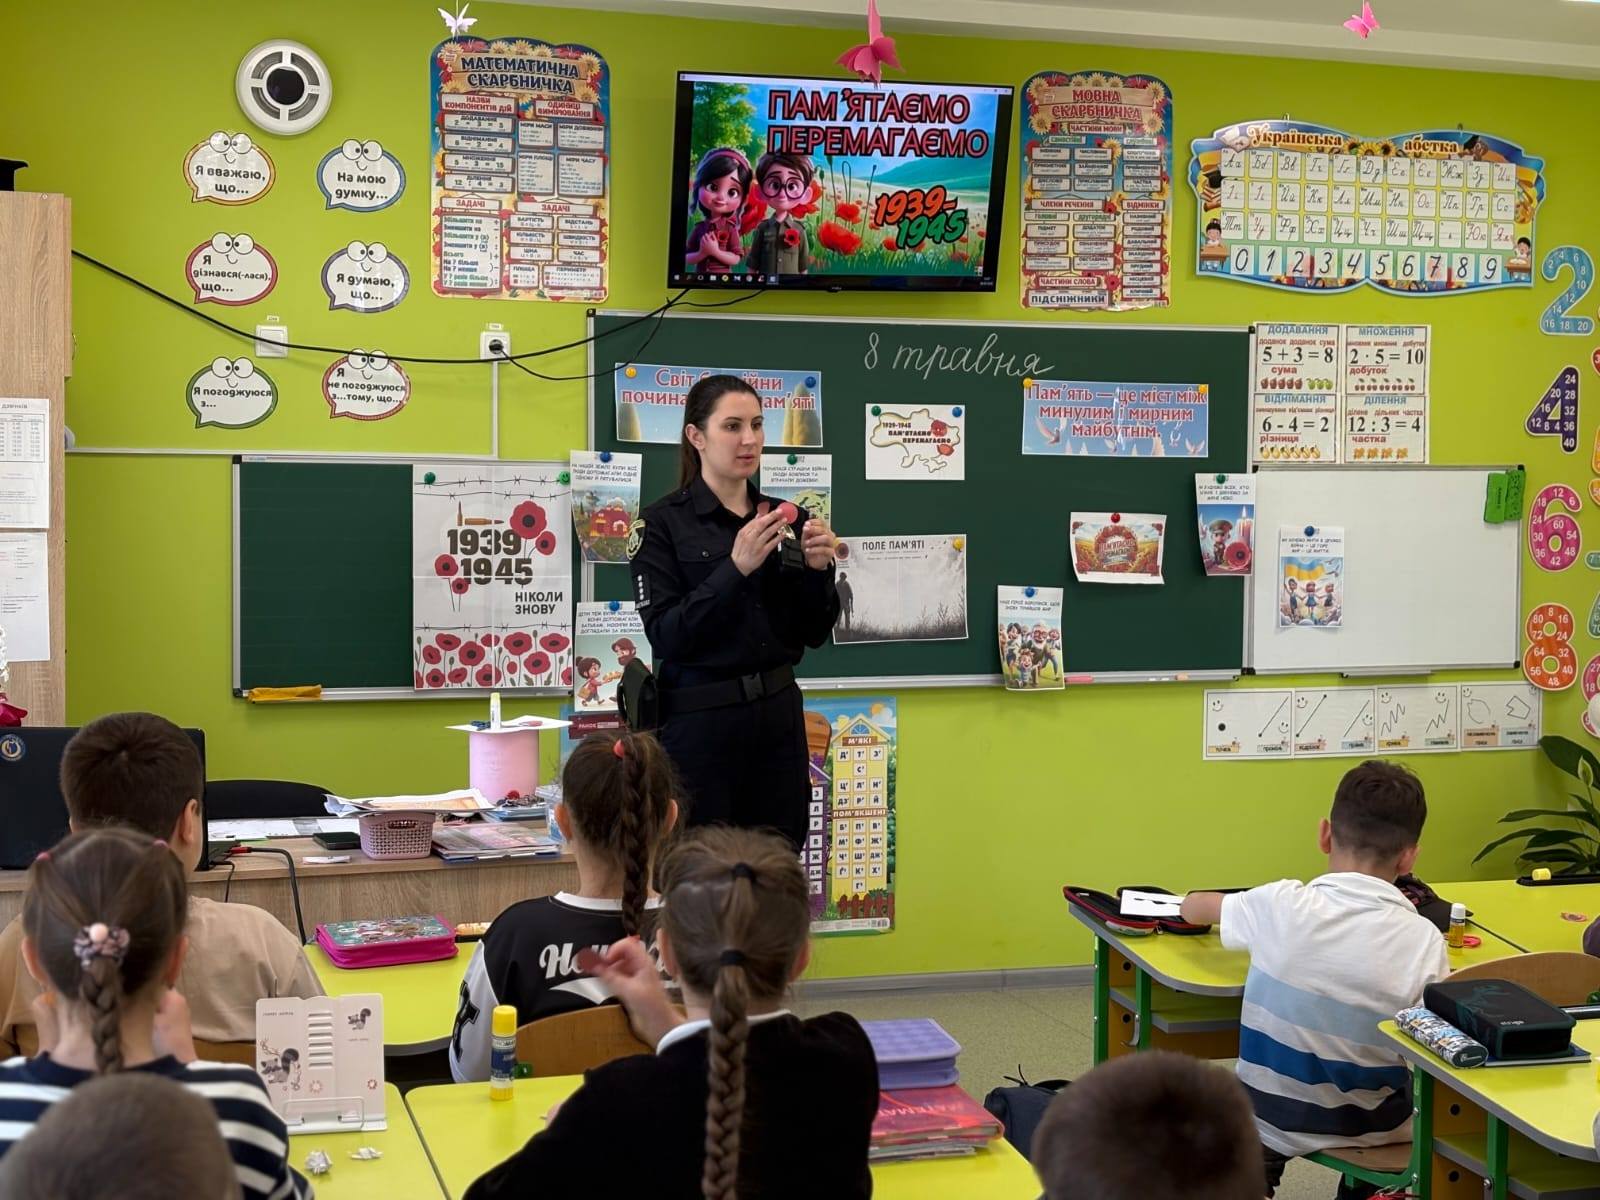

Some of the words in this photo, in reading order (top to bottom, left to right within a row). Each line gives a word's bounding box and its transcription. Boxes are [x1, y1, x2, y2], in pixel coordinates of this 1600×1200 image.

[461, 57, 579, 78] МАТЕМАТИЧНА
[467, 73, 573, 93] СКАРБНИЧКА
[1072, 89, 1121, 102] МОВНА
[445, 102, 497, 112] КОМПОНЕНТІВ
[499, 104, 512, 113] ДІЙ
[768, 88, 970, 123] ПАМ’ЯТАЄМО
[1052, 104, 1142, 121] СКАРБНИЧКА
[767, 124, 989, 158] ПЕРЕМАГАЄМО
[1247, 124, 1343, 147] Українська
[1404, 136, 1458, 153] абетка
[195, 165, 204, 176] Я
[207, 167, 266, 181] вважаю,
[337, 172, 354, 183] На
[356, 175, 386, 185] мою
[215, 183, 249, 195] що...
[335, 188, 388, 200] думку...
[456, 200, 485, 208] ЗАДАЧІ
[541, 204, 571, 213] ЗАДАЧІ
[874, 185, 958, 226] 1939-
[1040, 200, 1063, 208] ЧЛЕНИ
[1064, 201, 1094, 209] РЕЧЕННЯ
[1126, 201, 1159, 209] ВІДМІНКИ
[895, 208, 969, 248] 1945
[203, 255, 212, 265] Я
[1235, 248, 1249, 272] 0
[1266, 249, 1276, 272] 1
[1292, 250, 1304, 273] 2
[1319, 251, 1332, 274] 3
[1347, 252, 1362, 275] 4
[1375, 254, 1390, 276] 5
[1402, 254, 1415, 277] 6
[1430, 255, 1442, 278] 7
[1457, 256, 1469, 279] 8
[1485, 257, 1498, 280] 9
[336, 273, 345, 283] Я
[347, 275, 395, 288] думаю,
[201, 283, 234, 294] що...
[350, 290, 383, 301] що...
[1031, 294, 1105, 304] ПІДСНІЖНИКИ
[1268, 326, 1328, 335] ДОДАВАННЯ
[1359, 327, 1414, 336] МНОЖЕННЯ
[864, 332, 879, 370] 8
[892, 333, 1055, 380] травня
[1262, 346, 1272, 362] 5
[1293, 347, 1303, 363] 3
[1324, 347, 1334, 363] 8
[1350, 348, 1359, 364] 2
[1375, 348, 1384, 364] 5
[1407, 349, 1423, 364] 10
[336, 368, 345, 378] Я
[1271, 366, 1297, 375] сума
[1350, 366, 1387, 376] добуток
[656, 368, 695, 387] Світ
[1565, 375, 1576, 384] 24
[193, 387, 201, 395] Я
[203, 388, 272, 398] погоджуюся
[328, 382, 340, 390] не
[342, 382, 406, 394] погоджуюся
[1551, 388, 1561, 398] 20
[1027, 384, 1093, 401] Пам’ять
[1118, 392, 1136, 406] це
[1141, 387, 1171, 404] міст
[1176, 389, 1207, 404] між
[1264, 395, 1326, 404] ВІДНІМАННЯ
[1565, 390, 1576, 399] 28
[622, 390, 687, 406] почина
[762, 394, 815, 410] ам’яті
[1364, 396, 1406, 405] ДІЛЕННЯ
[1541, 403, 1550, 412] 16
[1564, 406, 1575, 415] 32
[1040, 405, 1114, 421] минулим
[1119, 405, 1124, 419] і
[1128, 408, 1193, 424] мирним
[1262, 416, 1272, 433] 6
[1288, 416, 1298, 433] 4
[1320, 416, 1329, 433] 2
[1349, 416, 1366, 433] 12
[1380, 416, 1390, 433] 3
[1411, 416, 1421, 433] 4
[1531, 418, 1541, 427] 12
[1544, 421, 1550, 431] 8
[1554, 421, 1560, 430] 4
[1564, 421, 1575, 431] 36
[1072, 420, 1161, 439] майбутнім.
[1260, 435, 1299, 444] різниця
[1352, 435, 1386, 443] частка
[1564, 438, 1575, 447] 40
[1553, 488, 1564, 497] 12
[1537, 498, 1547, 507] 18
[1569, 497, 1576, 505] 6
[1532, 515, 1542, 525] 24
[1553, 520, 1564, 529] 60
[1533, 532, 1543, 542] 30
[1566, 530, 1577, 540] 54
[447, 528, 522, 556] 1939
[862, 541, 886, 551] ПОЛЕ
[888, 539, 925, 550] ПАМ'ЯТІ
[1535, 549, 1545, 558] 36
[1564, 547, 1576, 556] 48
[1550, 556, 1561, 566] 42
[460, 557, 533, 585] 1945
[514, 591, 563, 603] НІКОЛИ
[515, 604, 556, 615] ЗНОВУ
[1548, 607, 1554, 616] 8
[1533, 614, 1544, 624] 80
[1558, 614, 1569, 624] 16
[1532, 631, 1543, 640] 72
[1557, 631, 1568, 641] 24
[1534, 647, 1545, 657] 64
[1558, 648, 1569, 657] 32
[1530, 666, 1541, 675] 56
[1562, 665, 1573, 675] 40
[1548, 677, 1560, 687] 48
